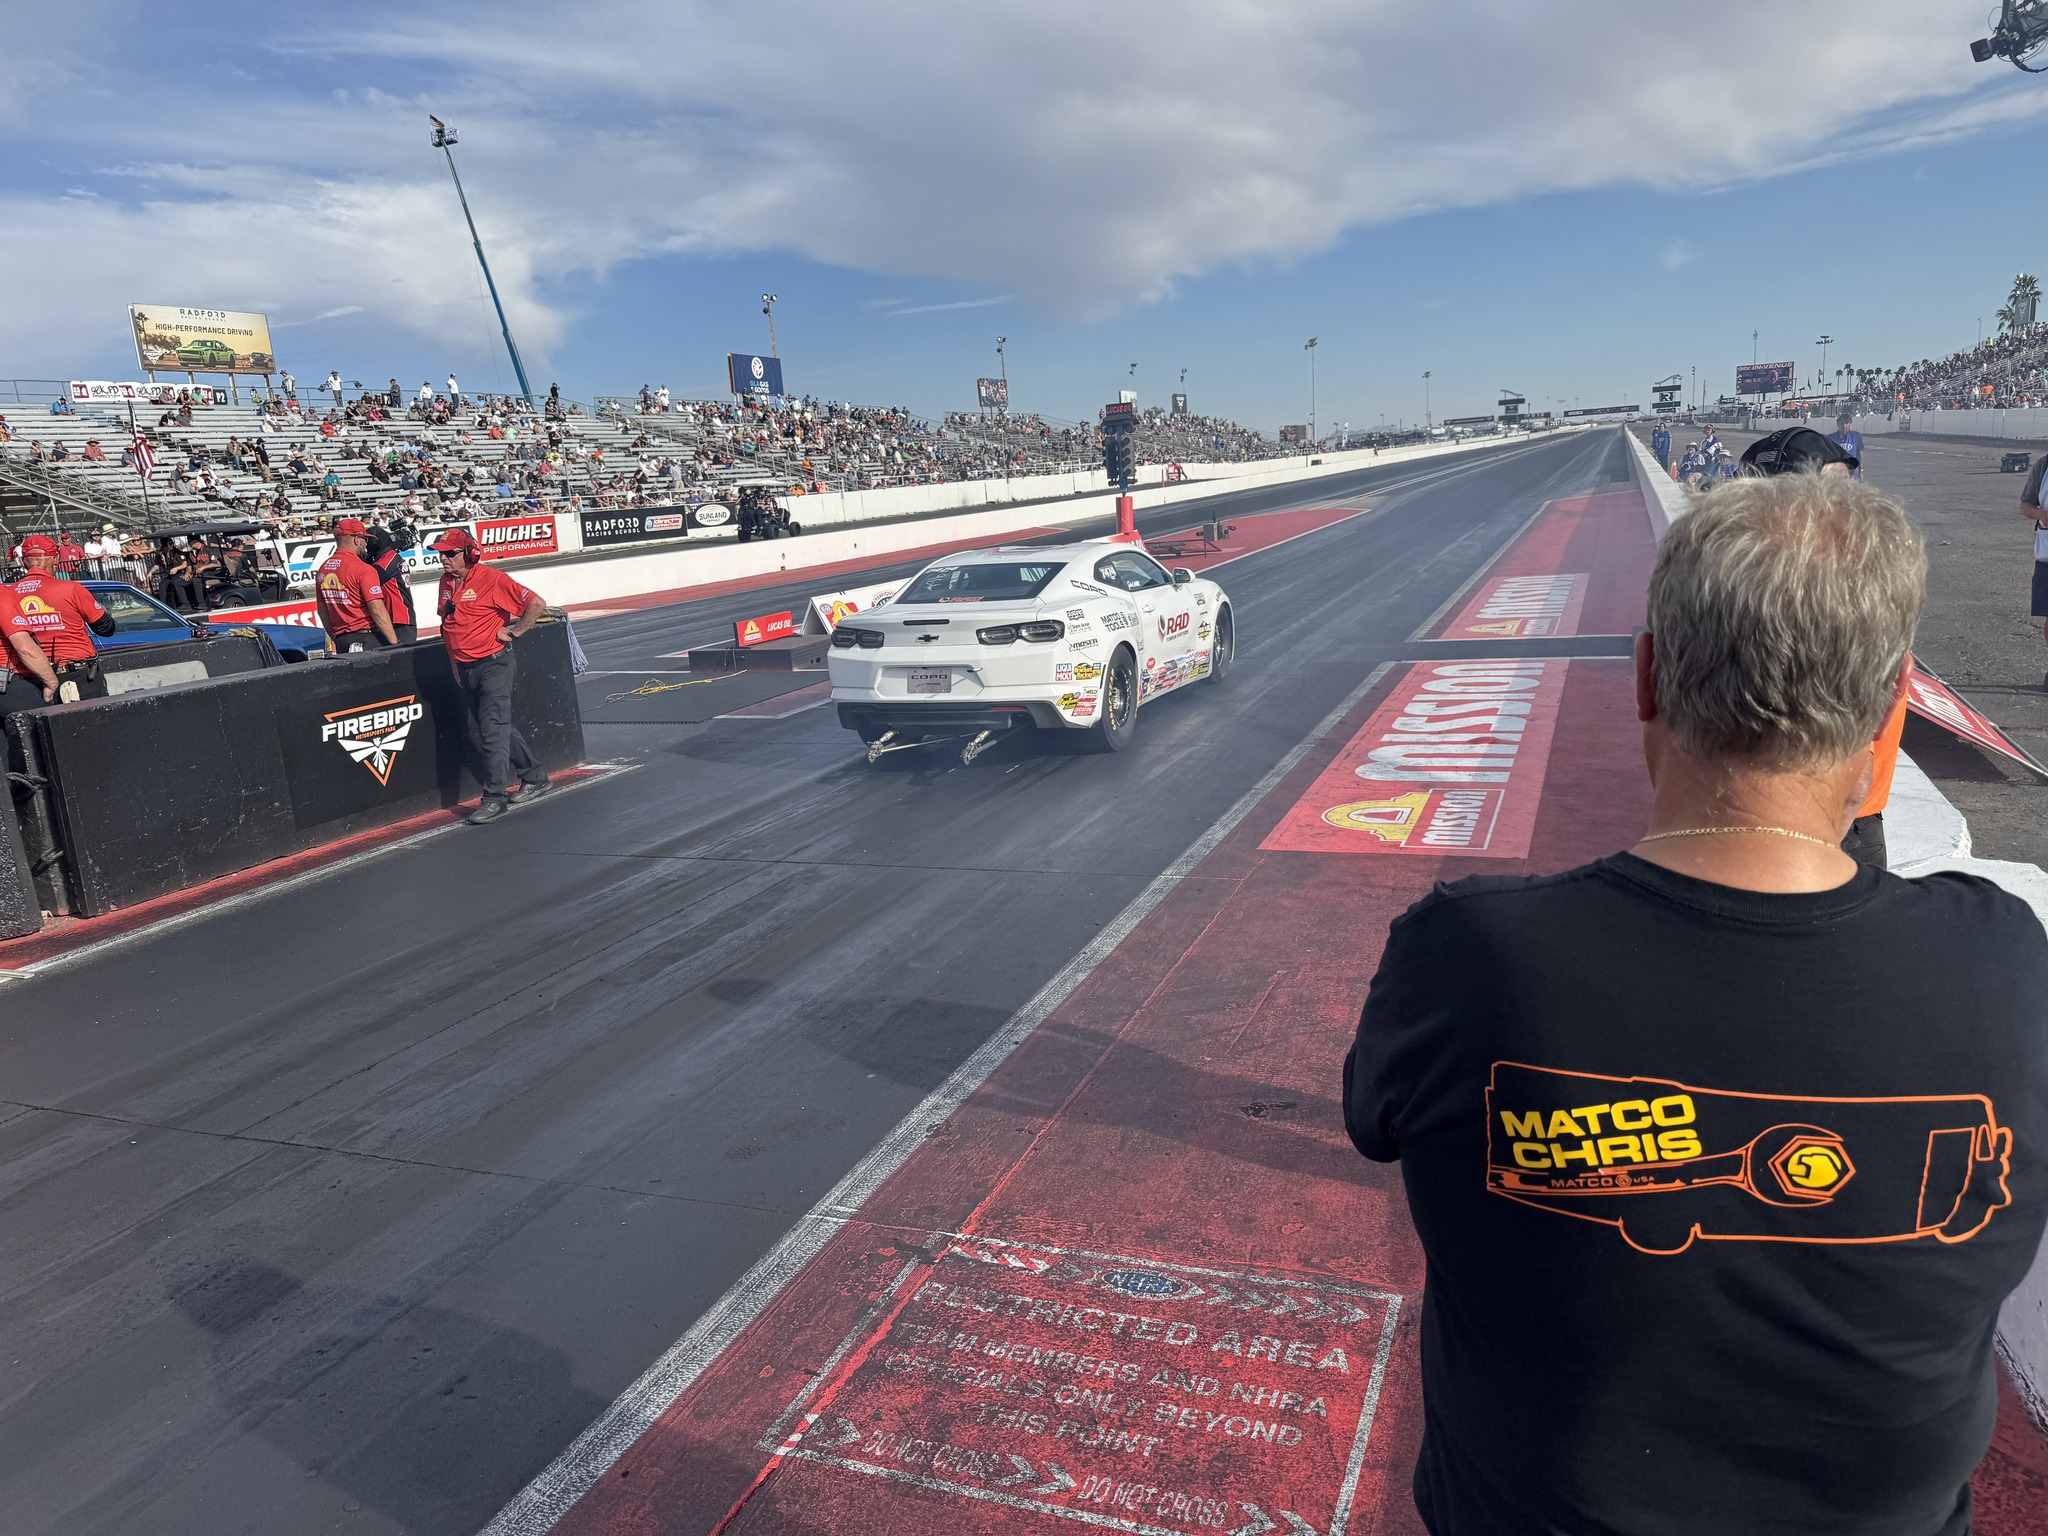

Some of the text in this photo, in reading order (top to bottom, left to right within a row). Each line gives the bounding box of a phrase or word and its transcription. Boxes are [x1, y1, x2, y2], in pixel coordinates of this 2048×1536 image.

[180, 308, 226, 319] RADFORD
[155, 322, 253, 337] HIGH-PERFORMANCE DRIVING
[215, 392, 226, 403] P2
[1107, 405, 1123, 414] LUCAS
[585, 517, 640, 532] RADFORD
[699, 512, 727, 521] SUNLAND
[481, 522, 553, 546] HUGHES
[586, 528, 641, 538] RACING SCHOOL
[483, 540, 554, 554] PERFORMANCE
[1070, 579, 1109, 597] COPO
[767, 619, 791, 632] LUCAS OIL
[1100, 612, 1121, 625] MATCO
[1105, 620, 1126, 632] TOOLS
[1166, 612, 1190, 636] RAD
[1056, 672, 1072, 681] MOLY
[321, 703, 423, 743] FIREBIRD
[1355, 661, 1546, 783] MISSION
[1420, 790, 1488, 847] MISSION
[1499, 1094, 1697, 1139] MATCO
[1512, 1128, 1702, 1169] CHRIS
[1550, 1173, 1656, 1189] MATCO USA
[1110, 1271, 1177, 1294] NHRA
[913, 1281, 1351, 1375] RESTRICTED AREA
[983, 1340, 1142, 1383] MEMBERS
[1150, 1367, 1221, 1398] AND
[1229, 1380, 1329, 1419] NHRA
[884, 1352, 1304, 1448] OFFICIALS ONLY BEYOND
[975, 1403, 1165, 1458] THIS POINT
[863, 1429, 896, 1456] DO
[891, 1435, 933, 1463] NOT
[1077, 1474, 1229, 1528] DO NOT CROSS
